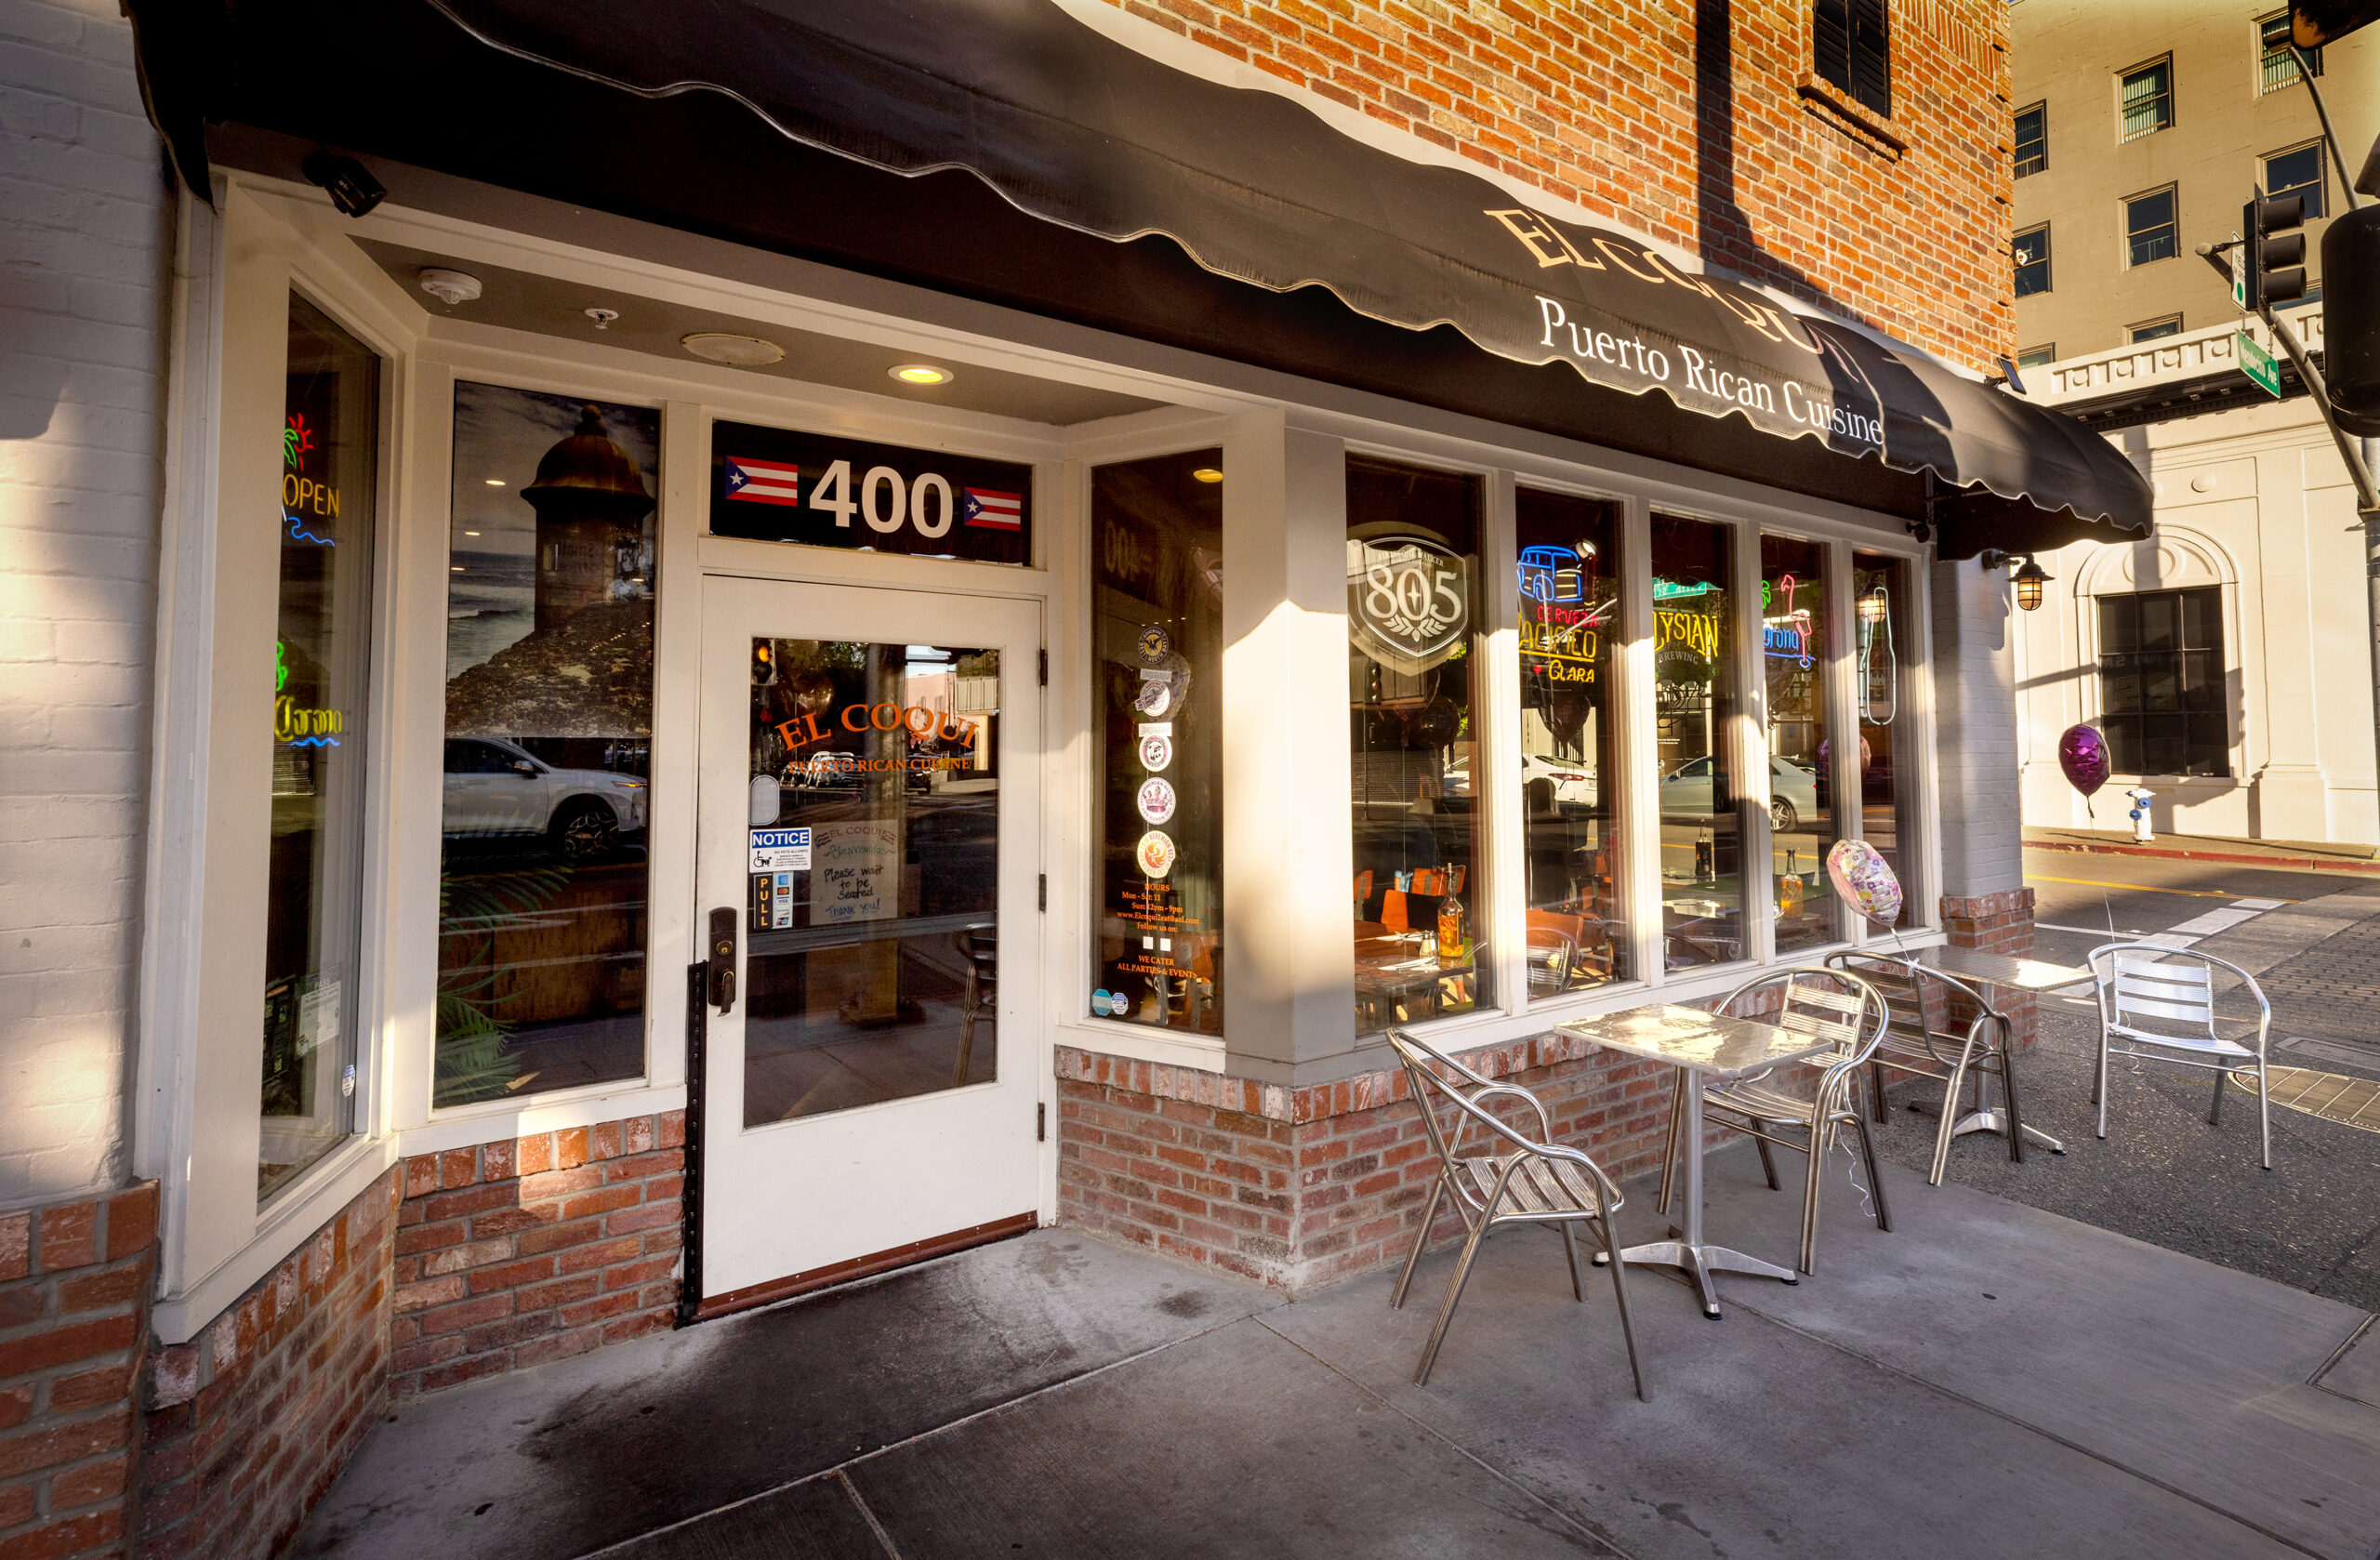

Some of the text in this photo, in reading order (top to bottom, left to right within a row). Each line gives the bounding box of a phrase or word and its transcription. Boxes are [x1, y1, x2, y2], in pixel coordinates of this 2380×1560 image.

[1483, 208, 1606, 270] EL
[1534, 295, 1884, 446] Puerto Rican Cuisine
[283, 473, 339, 518] OPEN
[809, 459, 954, 538] 400
[1366, 564, 1461, 623] 805
[1537, 605, 1598, 628] CERVEZA
[1518, 612, 1597, 658] ACIFICO
[1652, 611, 1719, 658] LYSIAN
[1763, 627, 1799, 651] orona
[1658, 650, 1699, 665] BREWING
[1548, 659, 1595, 682] CLARA
[274, 694, 342, 742] Corona
[774, 703, 980, 751] EL COQUI
[789, 758, 971, 773] PUERTO RICAN CUISINE
[752, 832, 809, 846] NOTICE
[829, 828, 843, 838] EL
[824, 865, 884, 883] Please wait
[840, 878, 870, 890] to be
[1144, 883, 1170, 892] HOURS
[760, 878, 769, 926] PULL
[1131, 902, 1146, 910] Sun:
[1146, 904, 1164, 912] 12pm
[1169, 905, 1183, 914] 9pm
[1137, 921, 1158, 931] Follow
[1117, 962, 1131, 971] ALL
[1131, 964, 1161, 974] PARTIES
[1169, 968, 1197, 979] EVENTS
[1138, 955, 1174, 966] WE CATER
